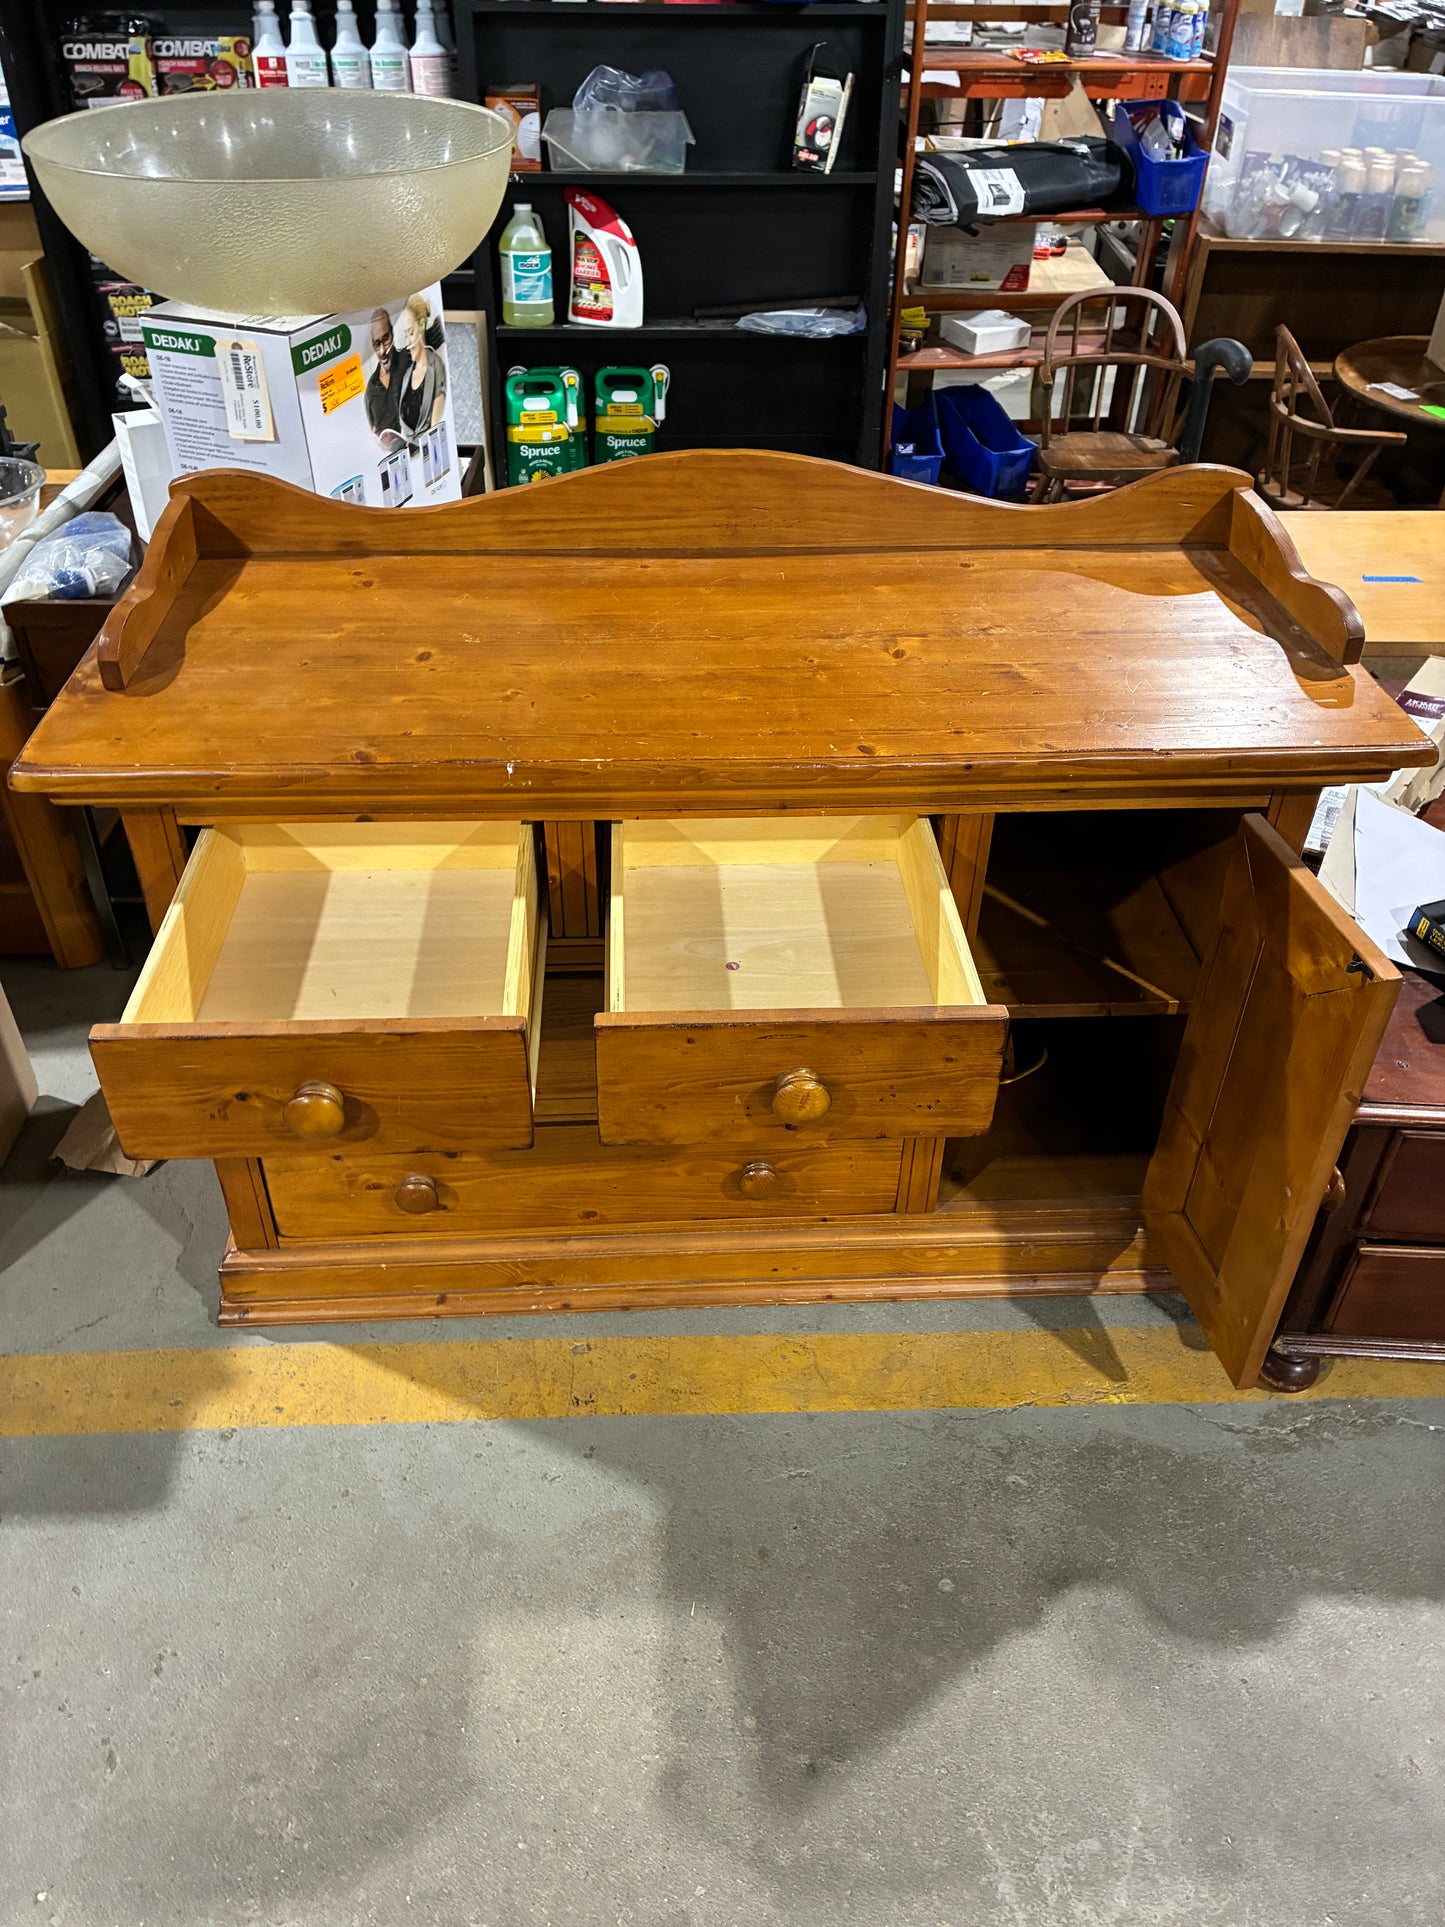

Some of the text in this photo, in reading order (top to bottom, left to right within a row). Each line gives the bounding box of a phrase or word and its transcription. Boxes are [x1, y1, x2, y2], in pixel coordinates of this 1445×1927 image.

[108, 295, 153, 307] ROACH
[151, 333, 201, 352] DEDAKJ
[302, 333, 342, 366] DEDAKJ
[243, 354, 255, 389] ReStore
[607, 436, 647, 450] Spruce
[520, 445, 561, 459] Spruce
